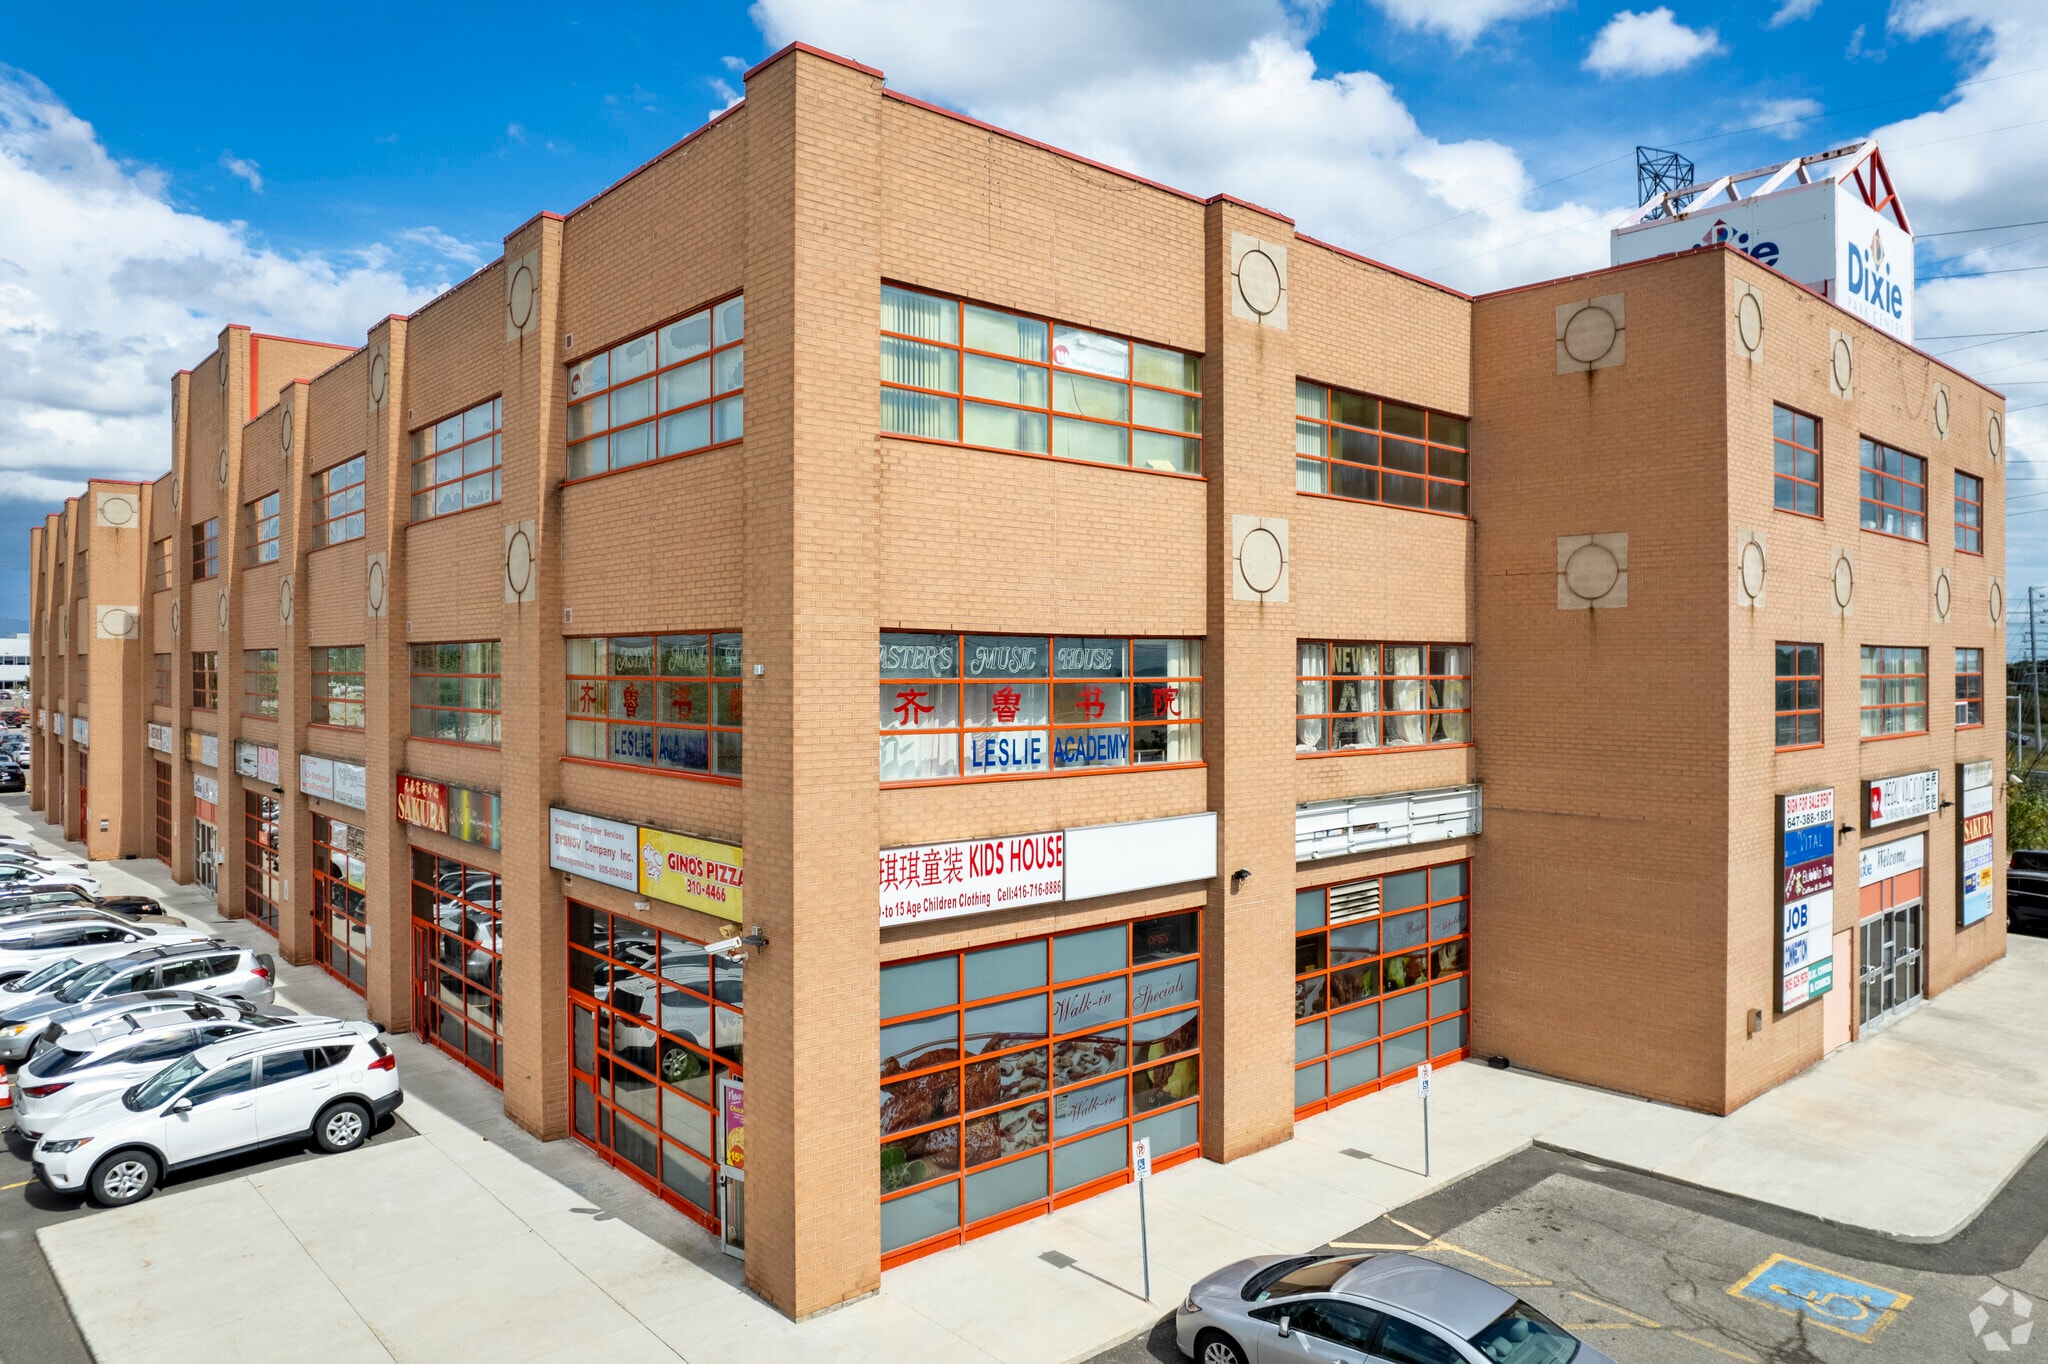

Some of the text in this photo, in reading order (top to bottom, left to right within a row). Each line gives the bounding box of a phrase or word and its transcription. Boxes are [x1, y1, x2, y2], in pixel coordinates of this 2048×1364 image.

[1848, 241, 1903, 319] Dixie
[970, 646, 1037, 674] MUSIC
[1058, 647, 1114, 670] HOUSE
[972, 734, 1129, 767] LESLIE ACADEMY
[398, 793, 448, 833] SAKURA
[1787, 809, 1832, 829] 647-388-1881
[1963, 814, 1993, 843] SAKURA
[584, 840, 616, 860] Company
[620, 848, 634, 863] Inc.
[667, 852, 704, 878] GINO'S
[969, 835, 1063, 879] KIDS HOUSE
[1877, 848, 1907, 869] Welcome
[879, 848, 964, 894] 琪琪童装
[686, 878, 727, 902] 310-4466
[895, 902, 905, 917] 15
[906, 898, 922, 918] Age
[923, 893, 957, 912] Children
[959, 891, 991, 908] Clothing
[1786, 904, 1808, 932] JOB
[1147, 932, 1169, 946] OPEN
[1053, 973, 1184, 1024] Walk-in Specials
[1066, 1094, 1116, 1122] Walk-in
